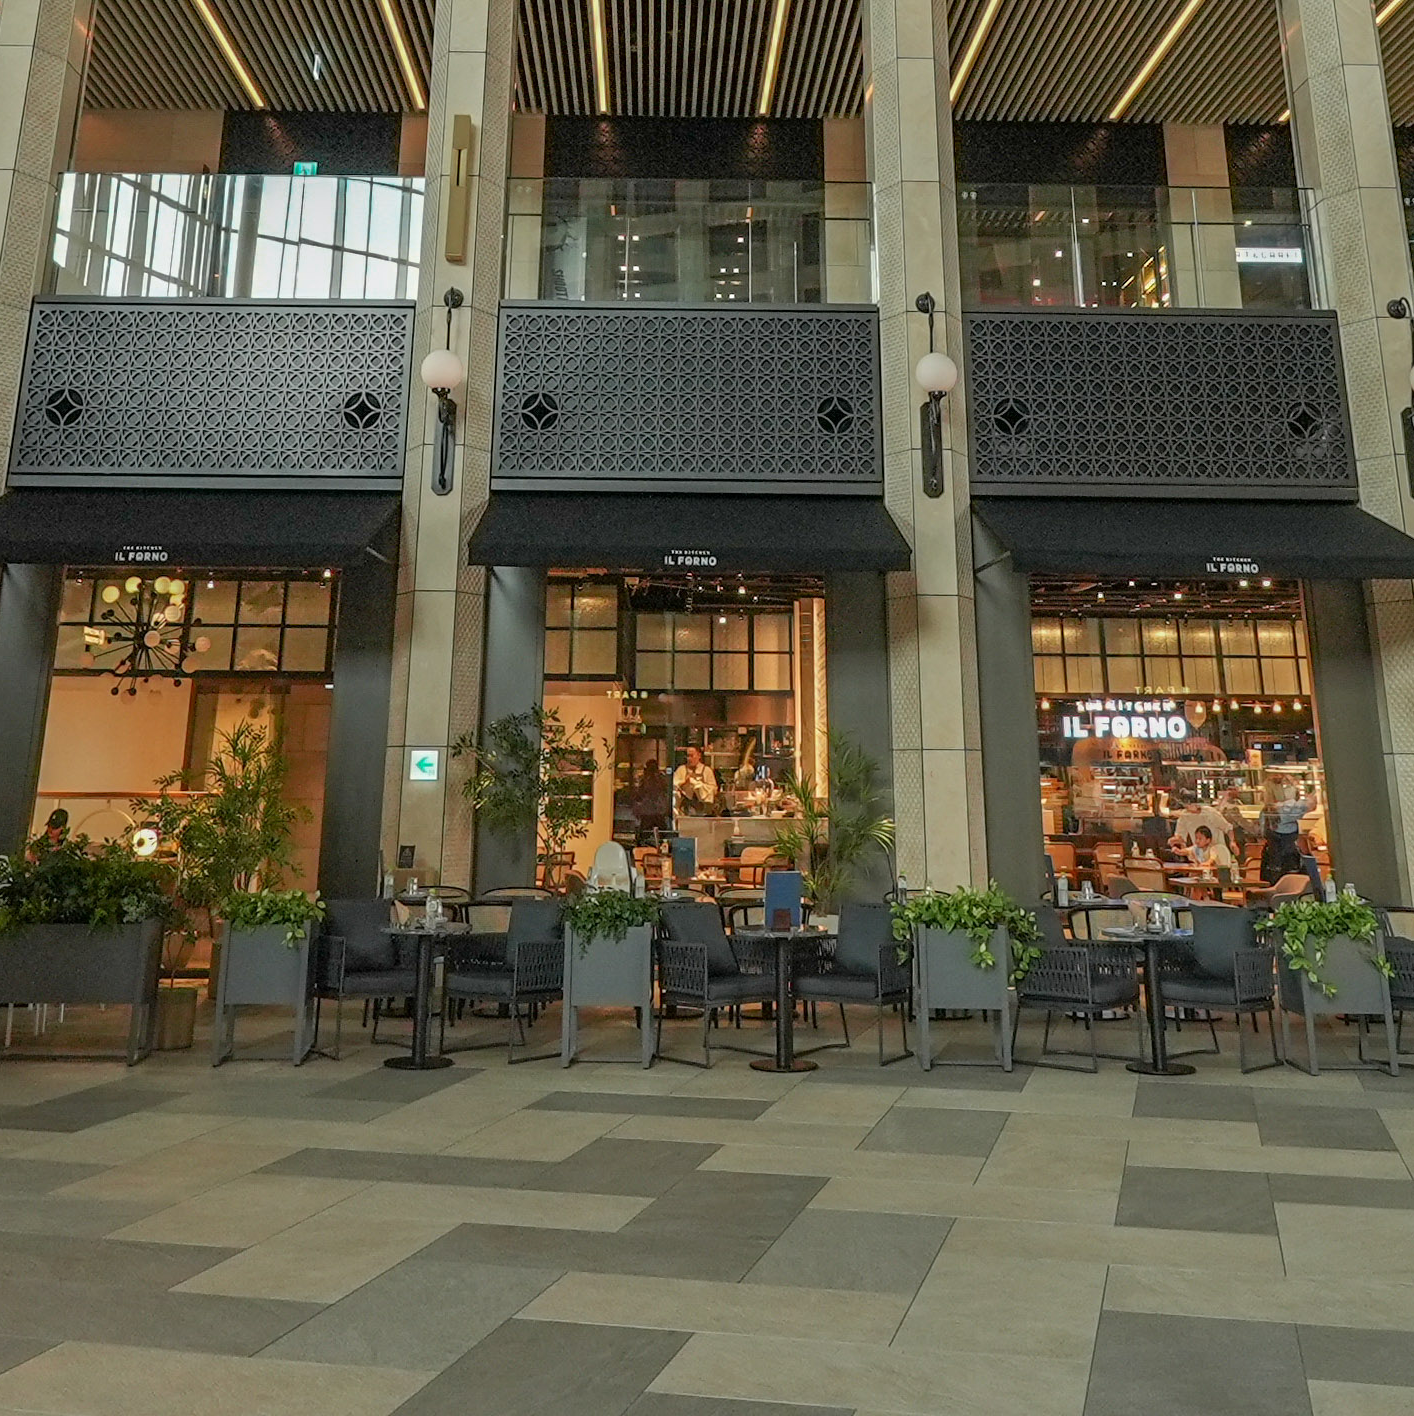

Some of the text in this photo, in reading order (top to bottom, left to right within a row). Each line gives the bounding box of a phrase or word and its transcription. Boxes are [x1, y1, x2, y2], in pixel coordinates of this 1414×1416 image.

[115, 551, 168, 562] IL FORNO
[664, 555, 717, 566] IL FORNO
[1206, 563, 1259, 574] IL FORNO
[1063, 716, 1187, 738] IL FORNO
